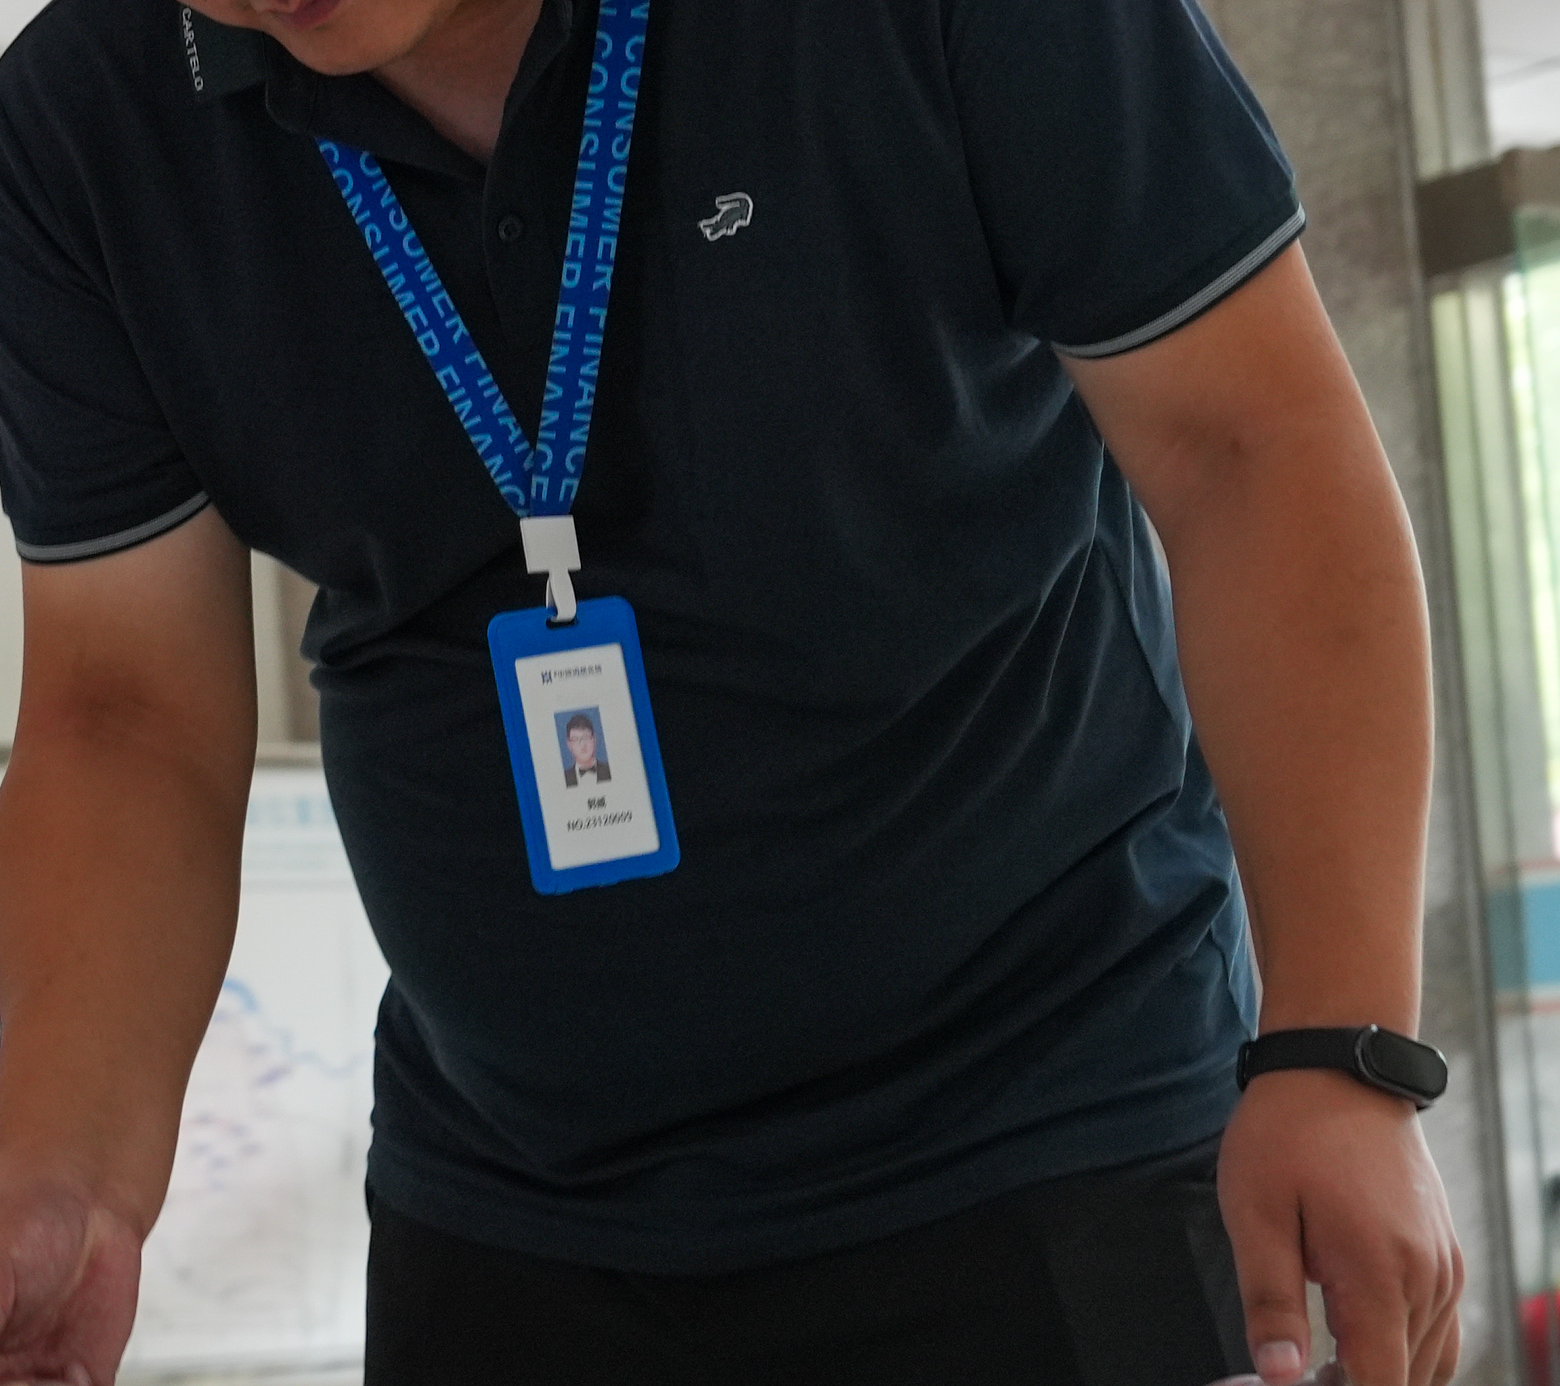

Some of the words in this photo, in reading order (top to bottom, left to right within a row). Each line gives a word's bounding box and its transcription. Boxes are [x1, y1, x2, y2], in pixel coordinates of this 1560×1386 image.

[182, 7, 204, 92] CARTELO
[592, 34, 646, 292] CONSUMER
[559, 306, 608, 502] FINANCE
